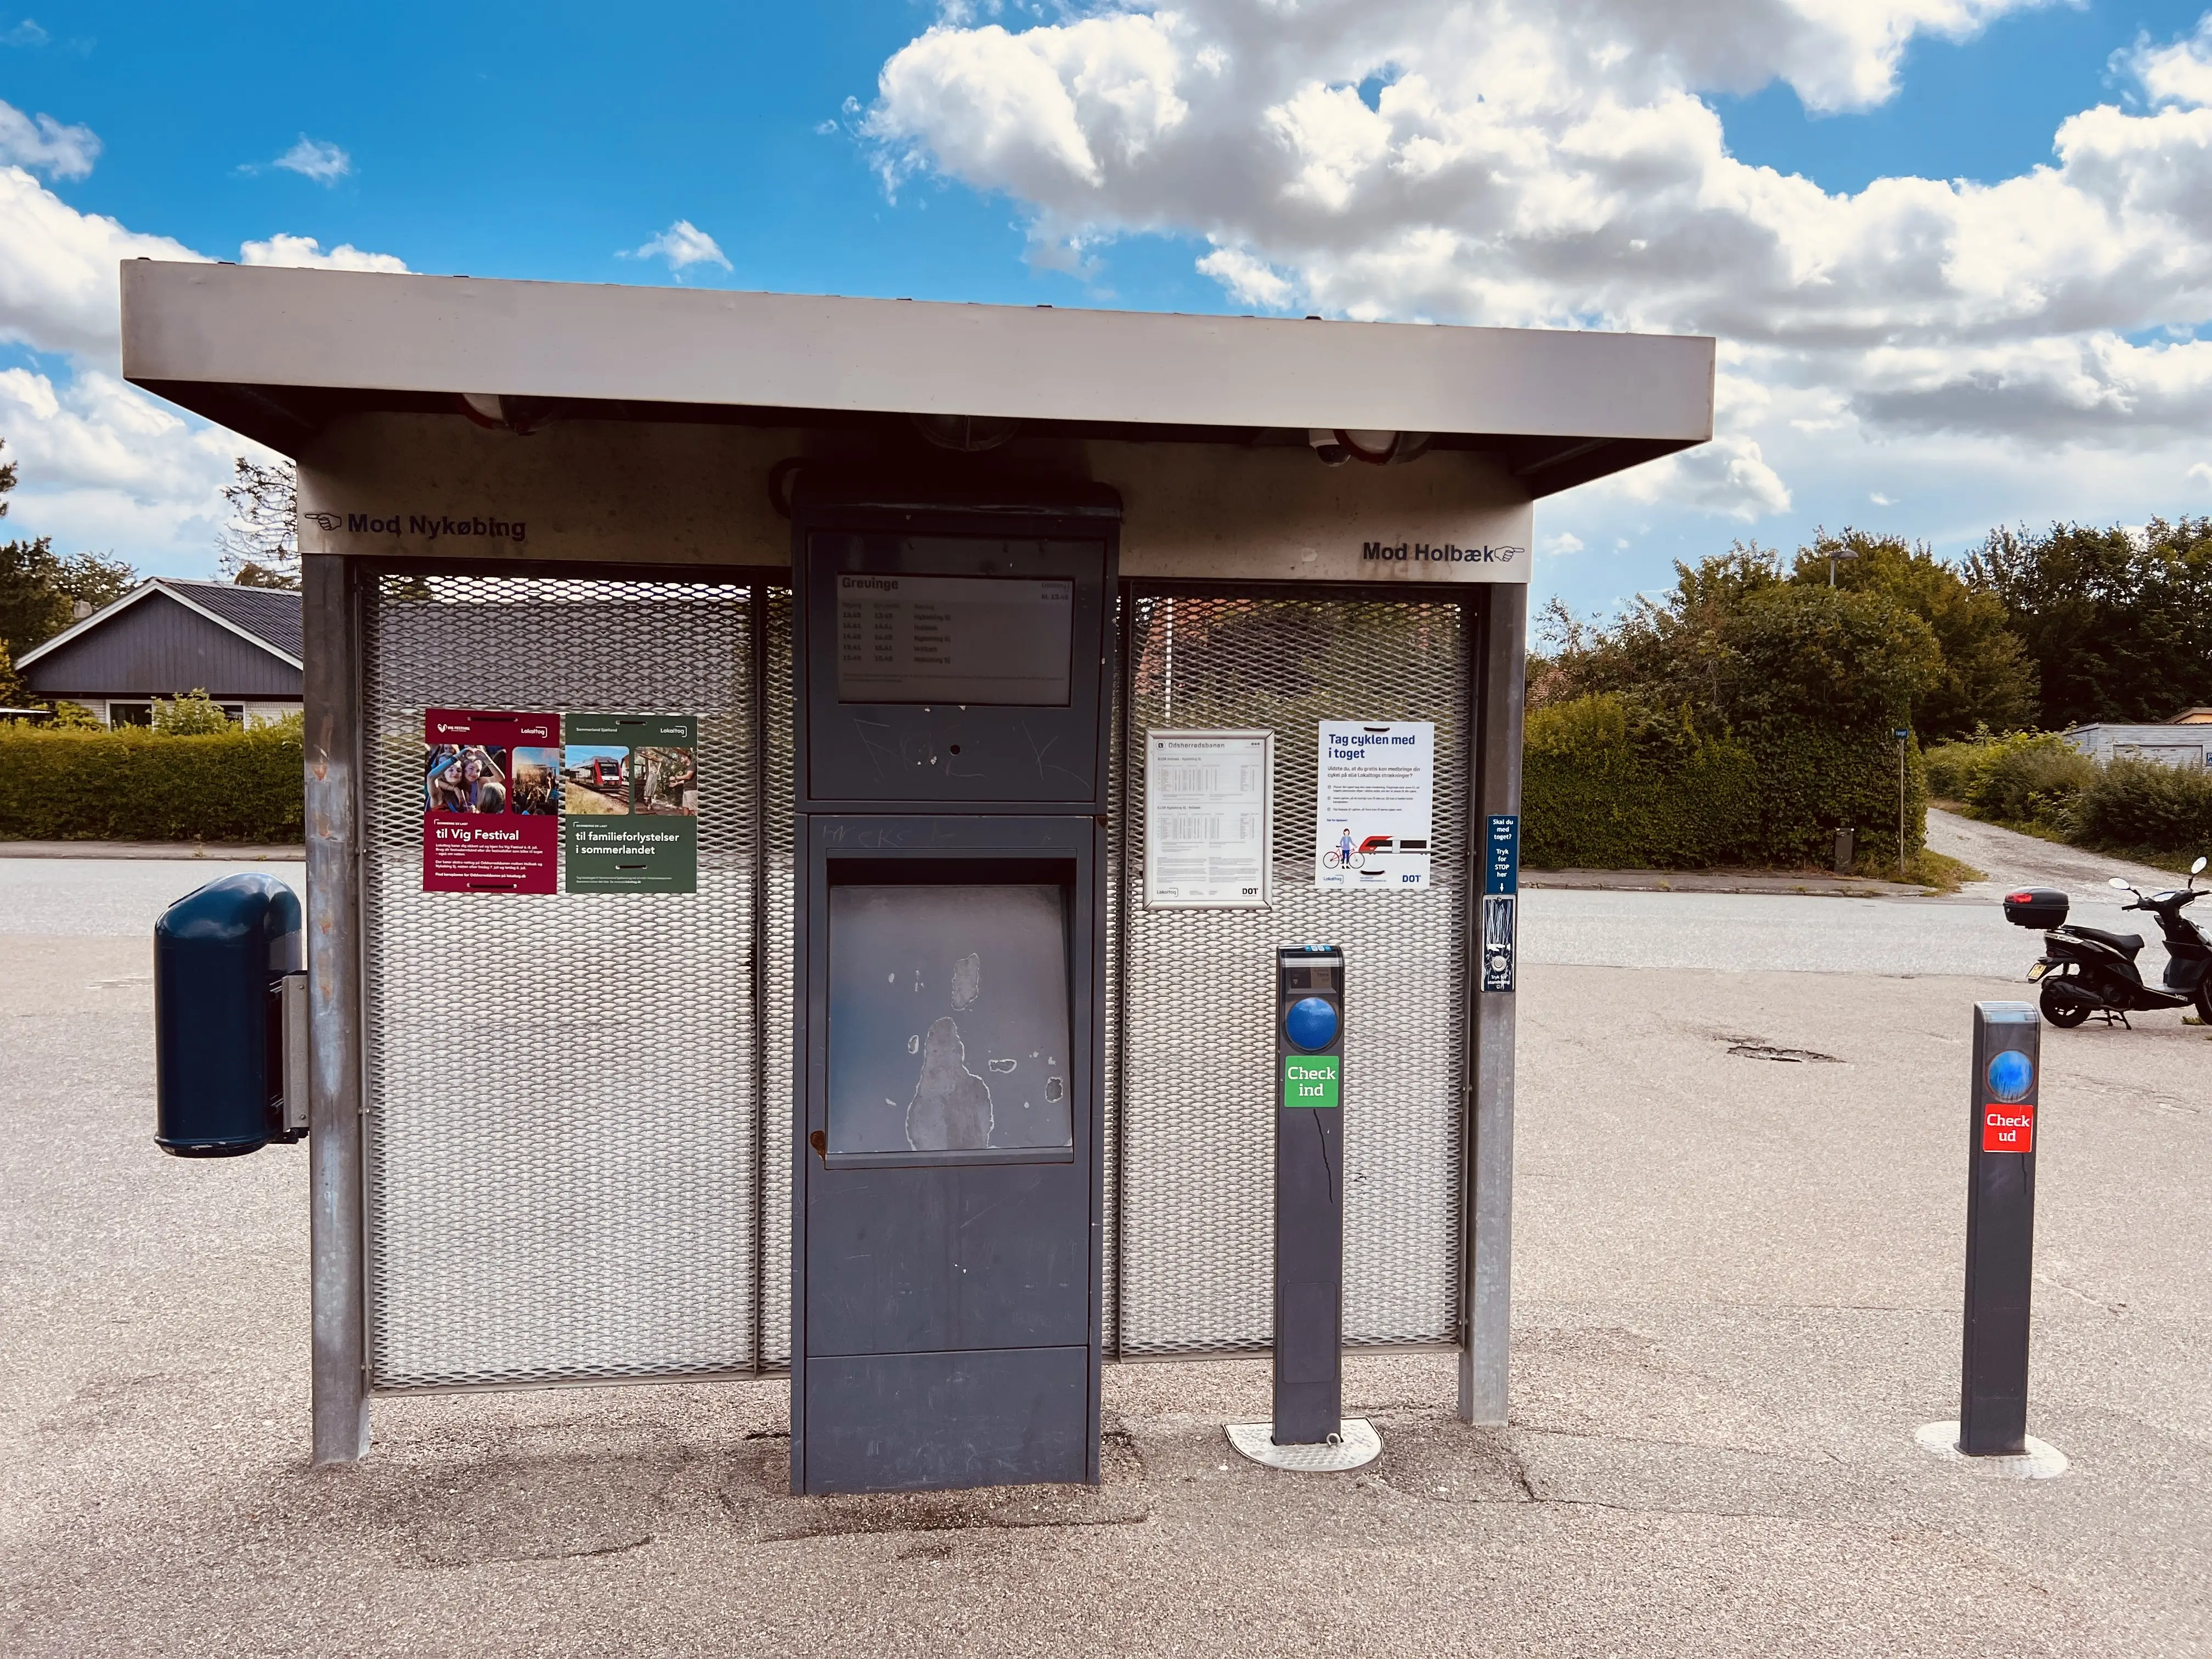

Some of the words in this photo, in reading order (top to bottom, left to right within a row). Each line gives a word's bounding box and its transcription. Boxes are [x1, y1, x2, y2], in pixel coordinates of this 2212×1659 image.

[348, 514, 400, 534] Mod
[410, 515, 526, 541] Nykøbing
[1363, 542, 1407, 560] Mod
[1415, 544, 1494, 562] Holbæk
[843, 577, 899, 591] Grevinge
[1329, 734, 1348, 746] Tag
[1351, 735, 1389, 746] cyklen
[1391, 735, 1415, 745] med
[1329, 747, 1331, 758] i
[1334, 749, 1365, 760] toget
[436, 828, 448, 838] til
[451, 829, 471, 842] Vig
[475, 829, 519, 840] Festival
[575, 832, 586, 841] til
[588, 831, 679, 844] familieforlystelser
[576, 845, 579, 854] i
[581, 845, 656, 854] sommerlandet
[1288, 1066, 1336, 1080] Check
[1299, 1084, 1324, 1096] ind
[1987, 1114, 2030, 1127] Check
[1998, 1130, 2016, 1142] ud
